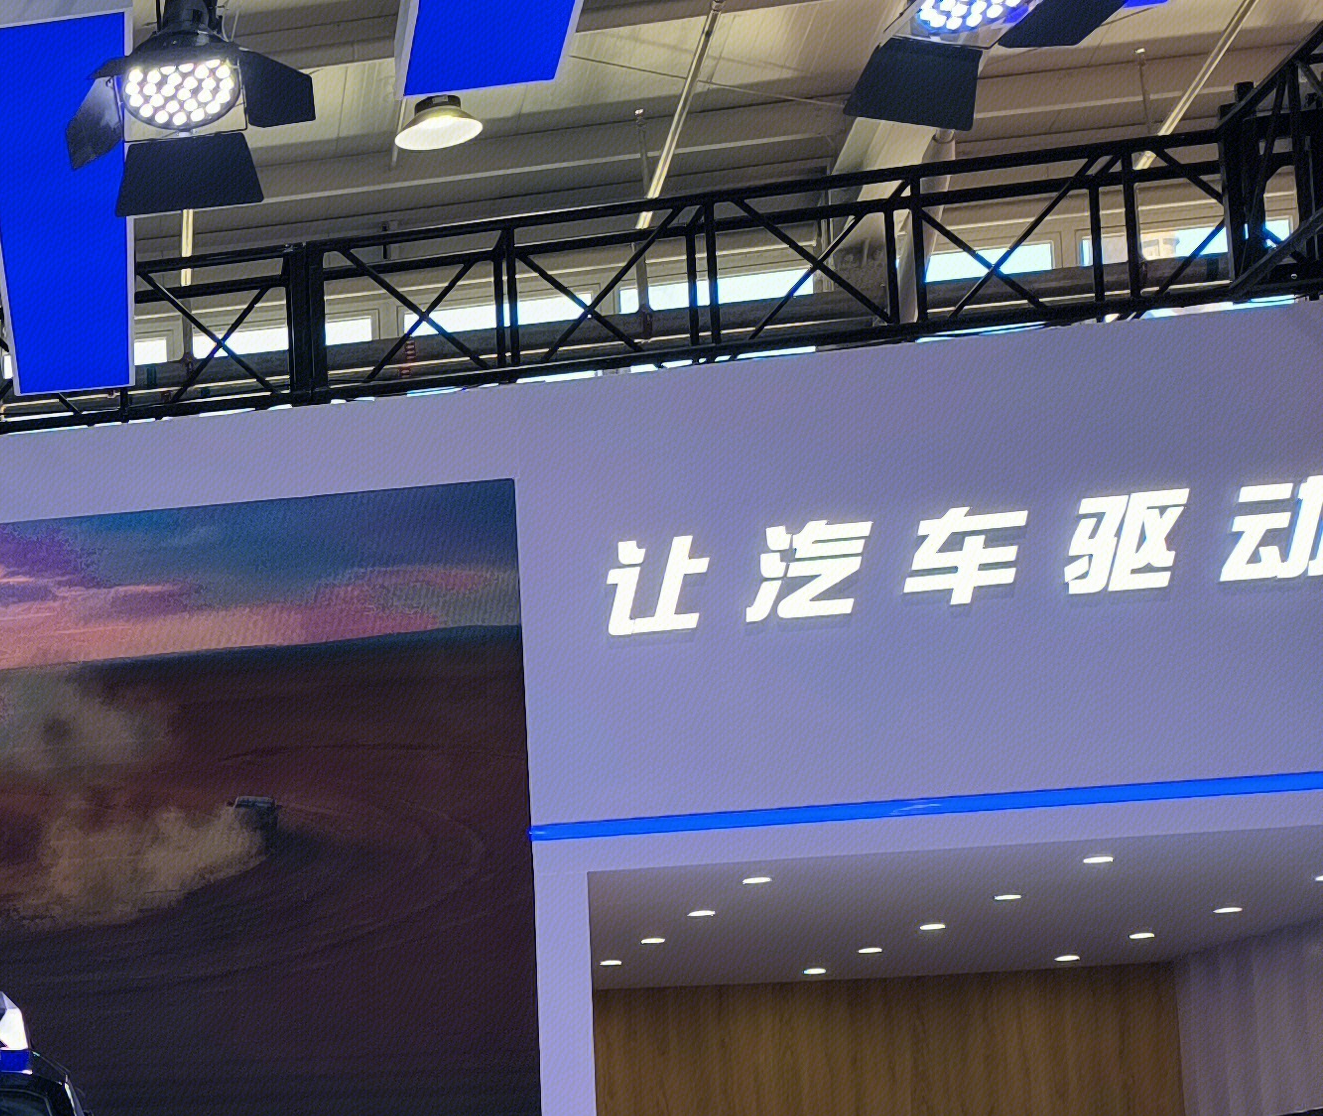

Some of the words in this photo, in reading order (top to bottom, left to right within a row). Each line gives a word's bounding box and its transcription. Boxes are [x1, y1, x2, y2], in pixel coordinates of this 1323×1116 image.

[606, 474, 1323, 637] 让汽车驱动
